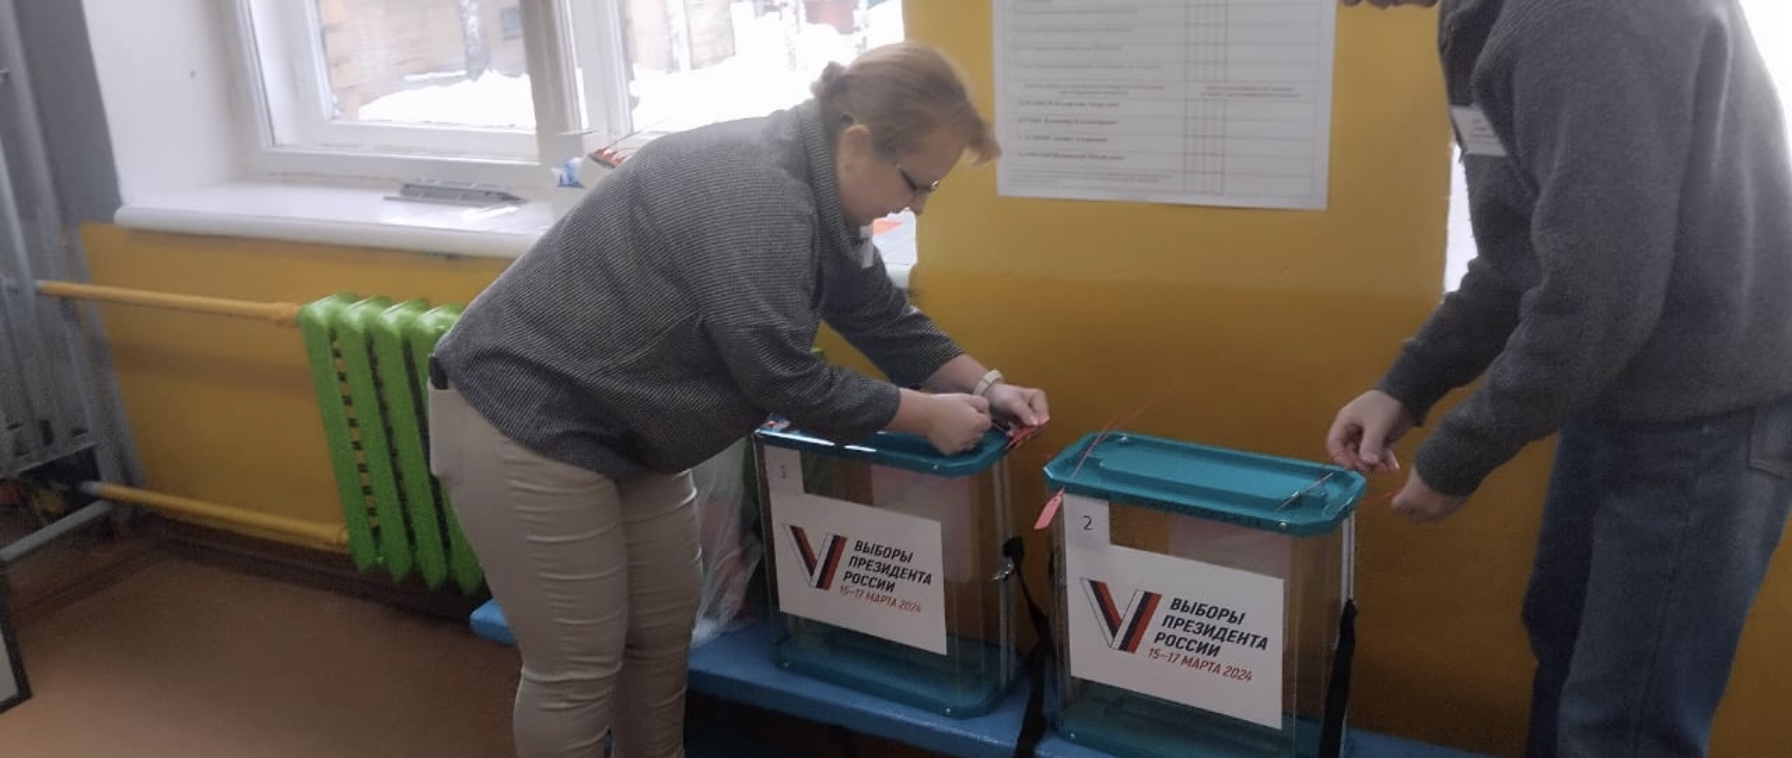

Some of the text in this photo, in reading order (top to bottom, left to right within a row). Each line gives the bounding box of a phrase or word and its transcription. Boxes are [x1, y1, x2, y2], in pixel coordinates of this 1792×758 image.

[1083, 515, 1094, 531] 2
[854, 540, 914, 563] ВЫБОРЫ
[842, 571, 896, 593] РОССИИ
[848, 555, 932, 585] ПРЕЗИДЕНТА
[864, 591, 897, 607] МАРТА
[1170, 597, 1246, 626] ВЫБОРЫ
[1153, 631, 1222, 658] РОССИИ
[1161, 614, 1269, 651] ПРЕЗИДЕНТА
[1180, 656, 1221, 675] МАРТА
[1222, 665, 1253, 682] 2024
